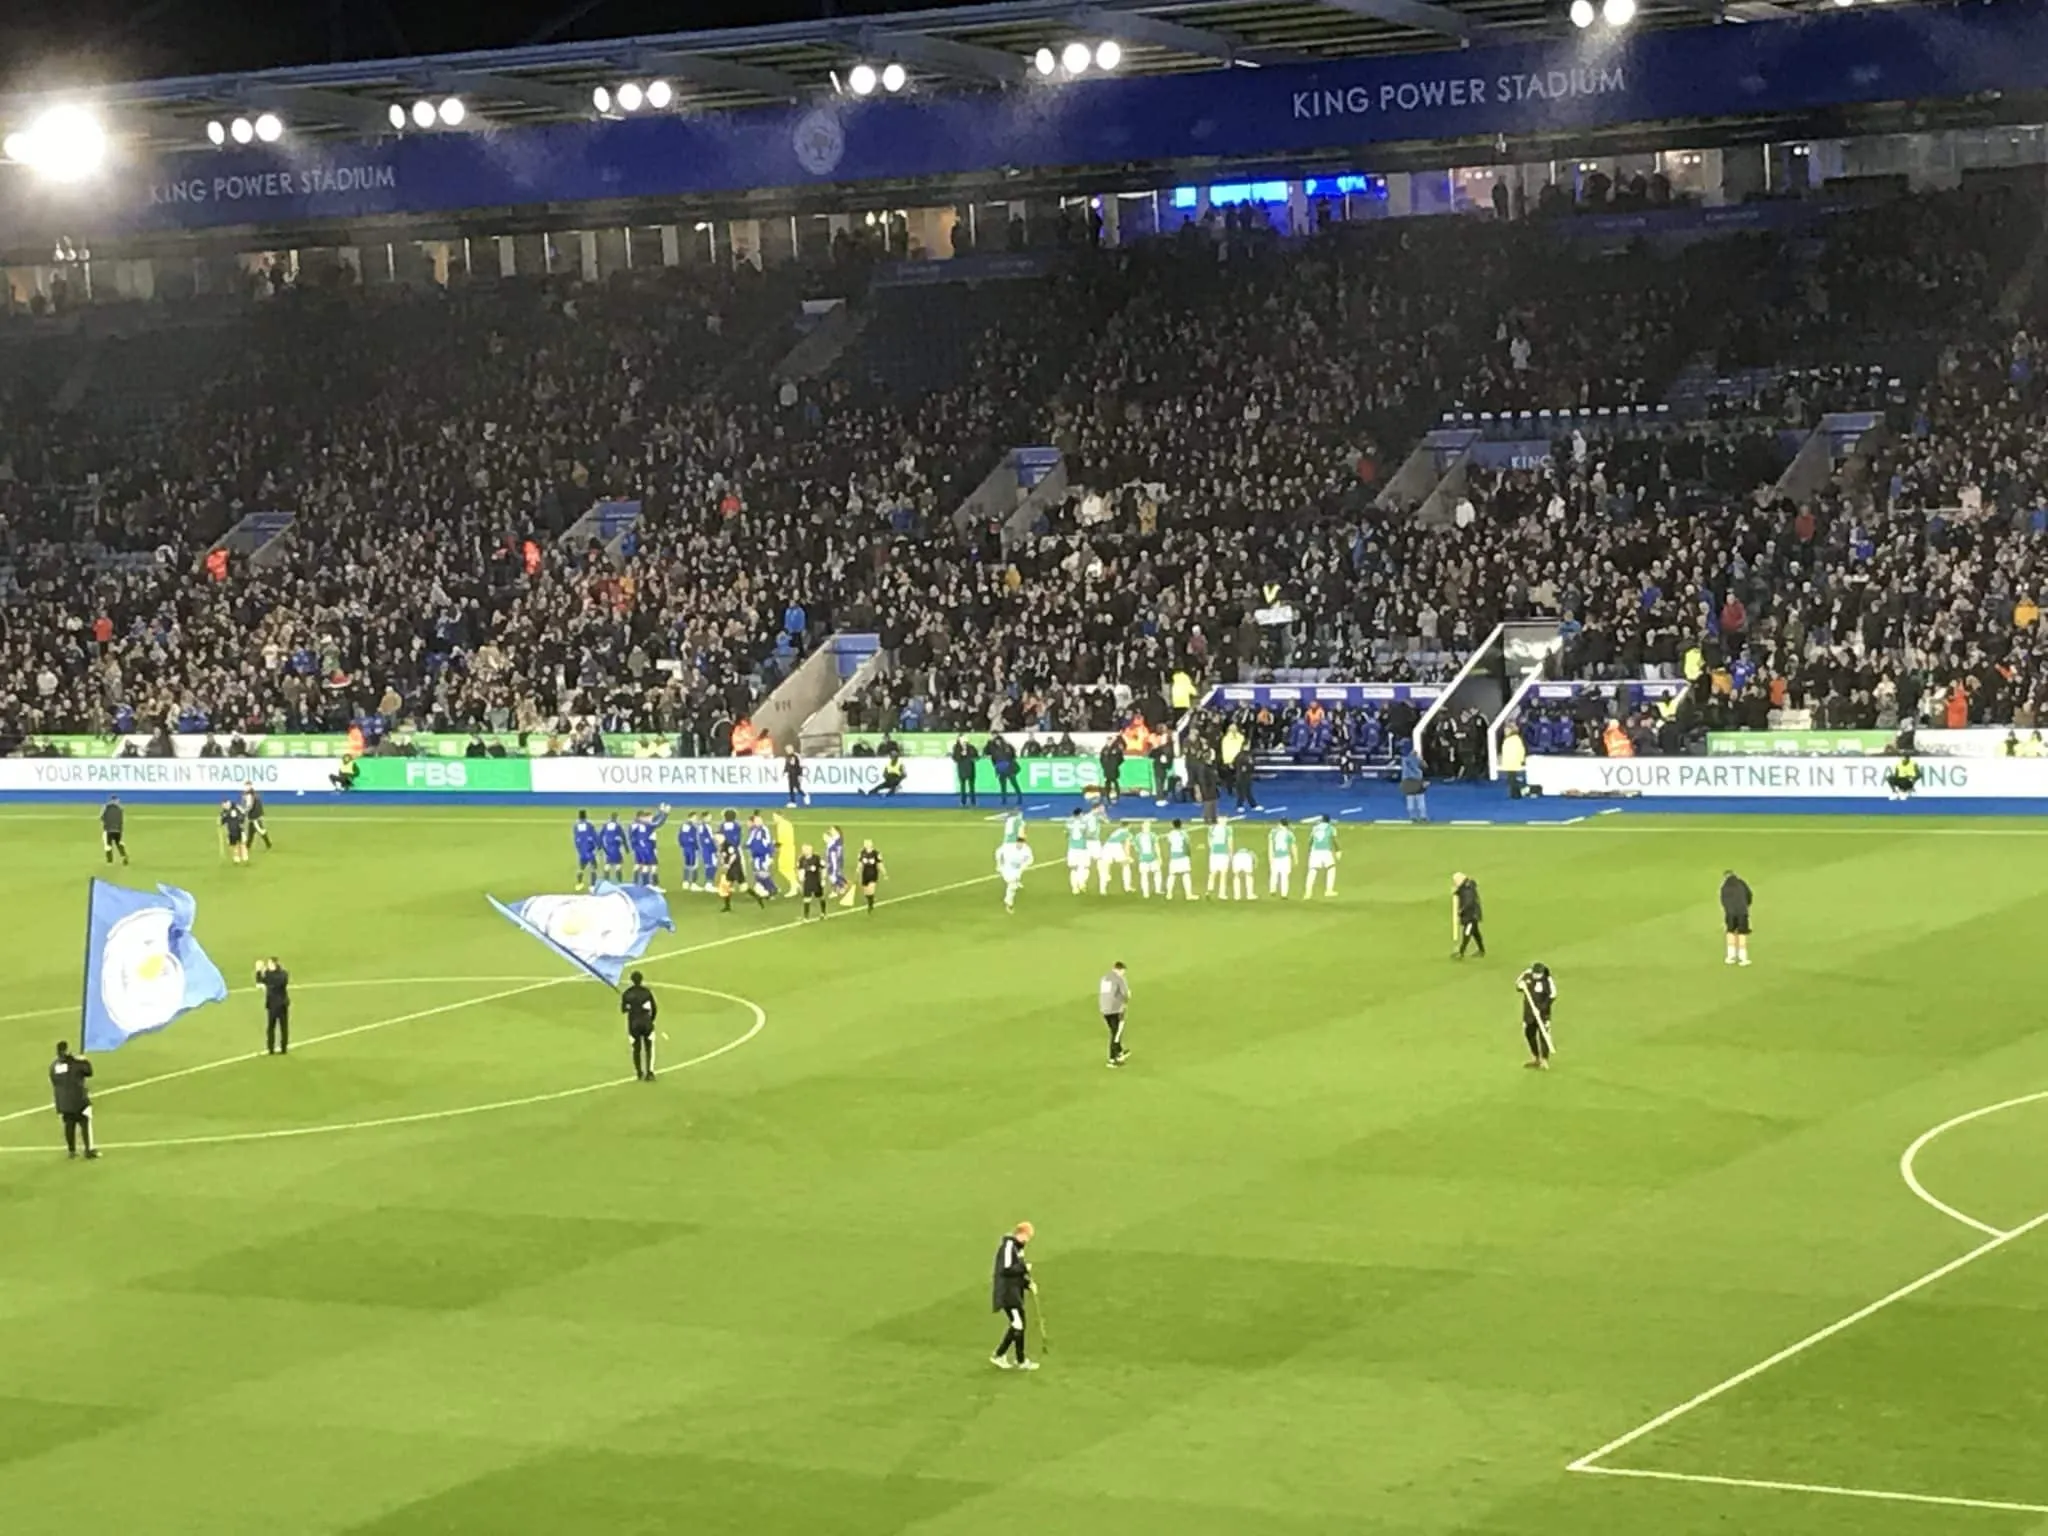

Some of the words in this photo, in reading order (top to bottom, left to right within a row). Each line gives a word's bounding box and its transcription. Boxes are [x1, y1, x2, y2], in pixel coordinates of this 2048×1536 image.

[1293, 87, 1370, 119] KING
[1380, 78, 1487, 112] POWER
[1496, 67, 1626, 103] STADIUM
[151, 178, 207, 205] KING
[213, 171, 295, 201] POWER
[300, 164, 397, 195] STADIUM
[34, 764, 83, 782] YOUR
[87, 764, 168, 782] PARTNER
[174, 765, 191, 782] IN
[197, 764, 279, 783] TRADING
[406, 761, 468, 788] FBS
[598, 765, 653, 784] YOUR
[659, 765, 752, 785] PARTNER
[758, 765, 779, 784] IN
[785, 764, 880, 785] RADING
[1029, 761, 1098, 788] FBS
[1599, 765, 1671, 787] YOUR
[1680, 765, 1801, 787] PARTNER
[1808, 765, 1835, 787] IN
[1844, 765, 1969, 787] TRAING
